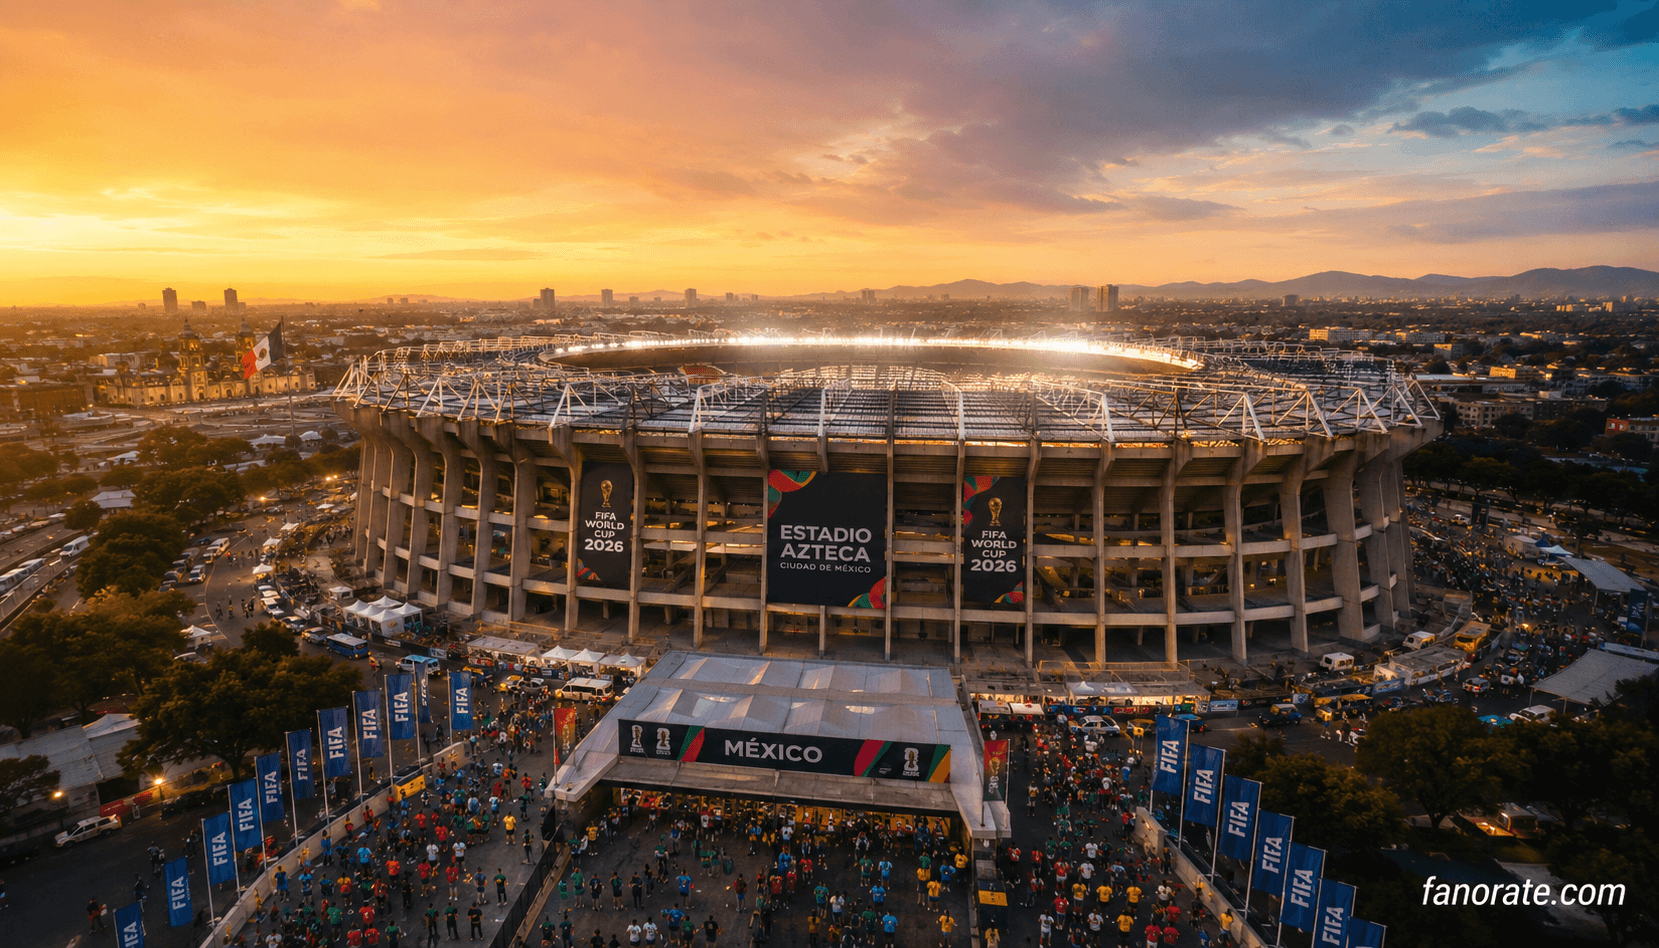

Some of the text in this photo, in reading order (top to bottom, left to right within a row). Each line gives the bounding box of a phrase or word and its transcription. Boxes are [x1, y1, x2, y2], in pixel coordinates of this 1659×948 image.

[585, 520, 625, 530] WORLD
[595, 511, 617, 520] FIFA
[584, 538, 624, 553] 2026
[594, 530, 615, 538] CUP
[780, 524, 872, 544] ESTADIO
[971, 539, 1017, 549] WORLD
[981, 530, 1007, 539] FIFA
[780, 543, 871, 562] AZTECA
[970, 558, 1017, 573] 2026
[982, 549, 1007, 558] CUP
[780, 562, 816, 571] CIUDAD
[835, 564, 871, 573] MÉXICO
[394, 692, 409, 722] FIFA
[456, 687, 469, 714] FIFA
[362, 709, 378, 739] FIFA
[328, 726, 345, 759] FIFA
[725, 737, 823, 763] MÉXICO
[296, 748, 308, 781] FIFA
[1160, 740, 1180, 774] FIFA
[264, 771, 278, 804] FIFA
[1194, 769, 1214, 804] FIFA
[238, 797, 255, 832] FIFA
[1228, 801, 1250, 838] FIFA
[211, 831, 229, 867] FIFA
[1261, 837, 1283, 874] FIFA
[171, 876, 187, 910] FIFA
[1291, 869, 1314, 908] FIFA
[123, 921, 139, 948] IFA
[1322, 906, 1344, 946] FIFA
